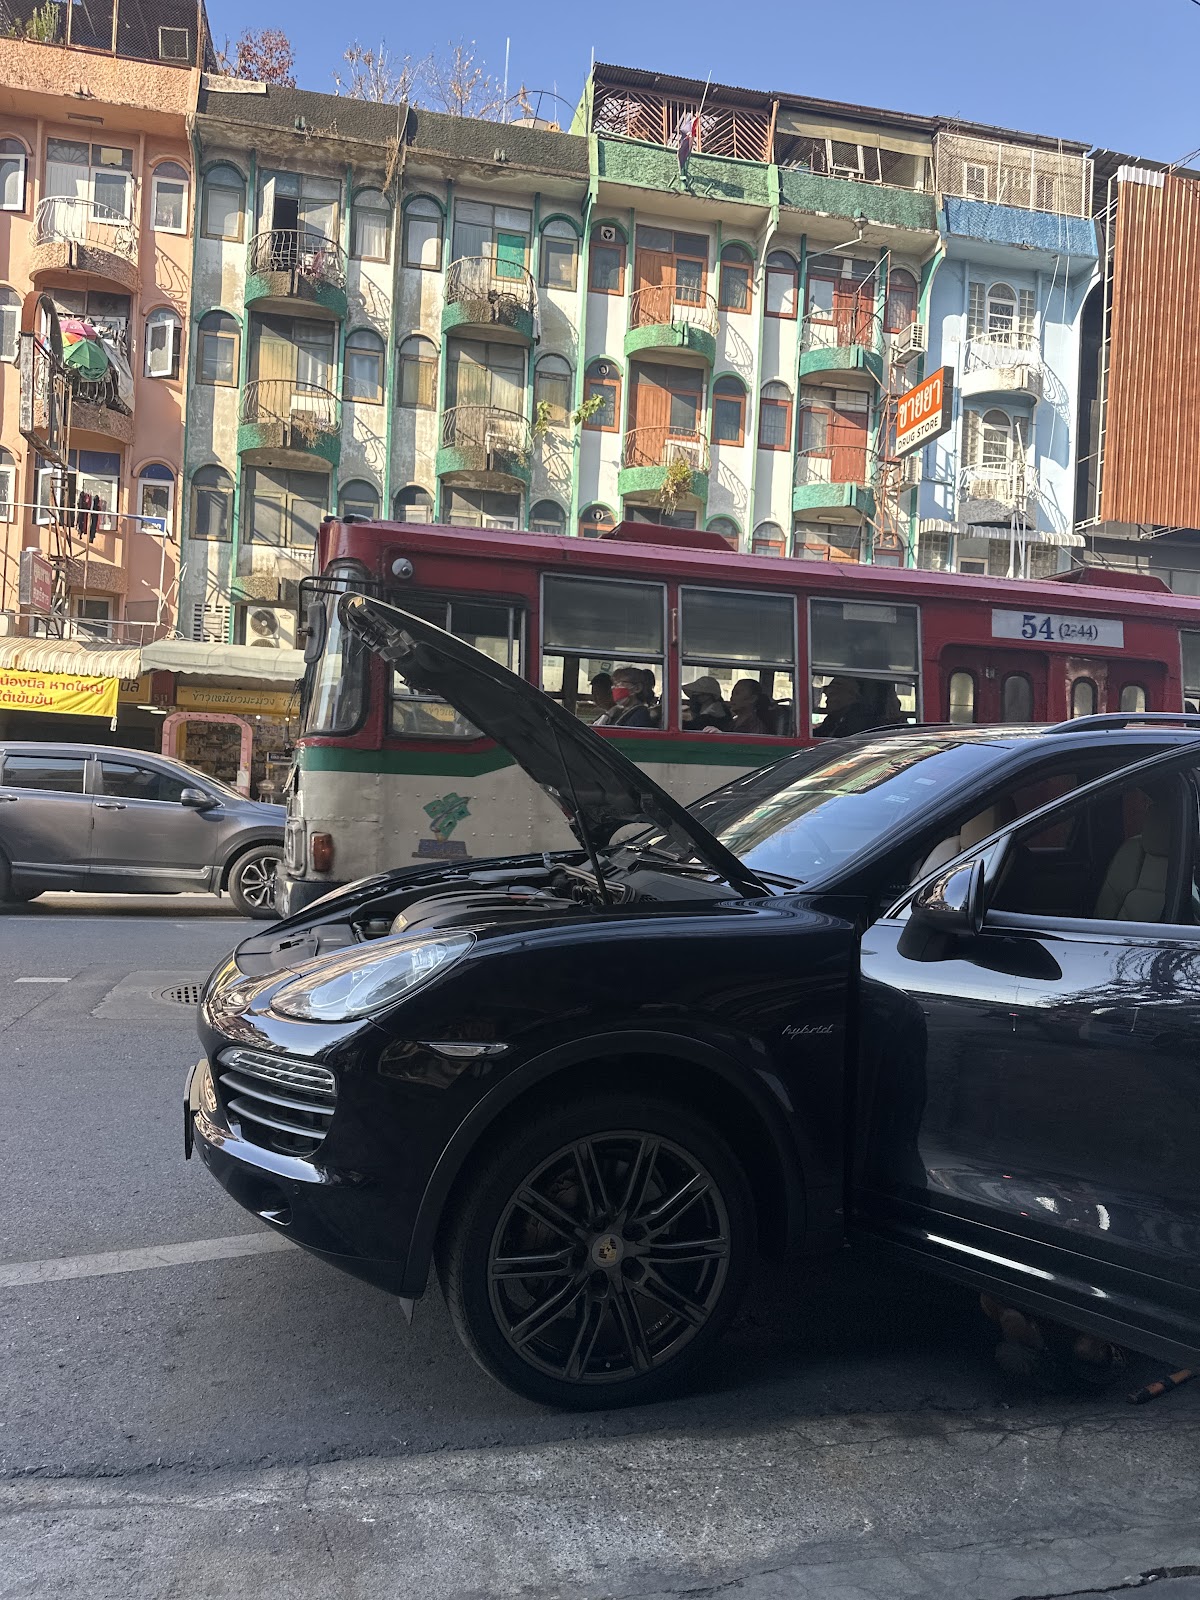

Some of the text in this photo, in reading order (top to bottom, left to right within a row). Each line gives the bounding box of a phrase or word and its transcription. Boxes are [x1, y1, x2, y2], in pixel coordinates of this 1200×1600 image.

[899, 379, 941, 428] ขายยา
[898, 416, 939, 450] DRUG STORE
[1021, 614, 1054, 640] 54
[50, 679, 105, 695] หาดใหญ่
[192, 690, 275, 706] ข้าวเหนียวมะม่วง
[781, 1023, 834, 1040] hybrid
